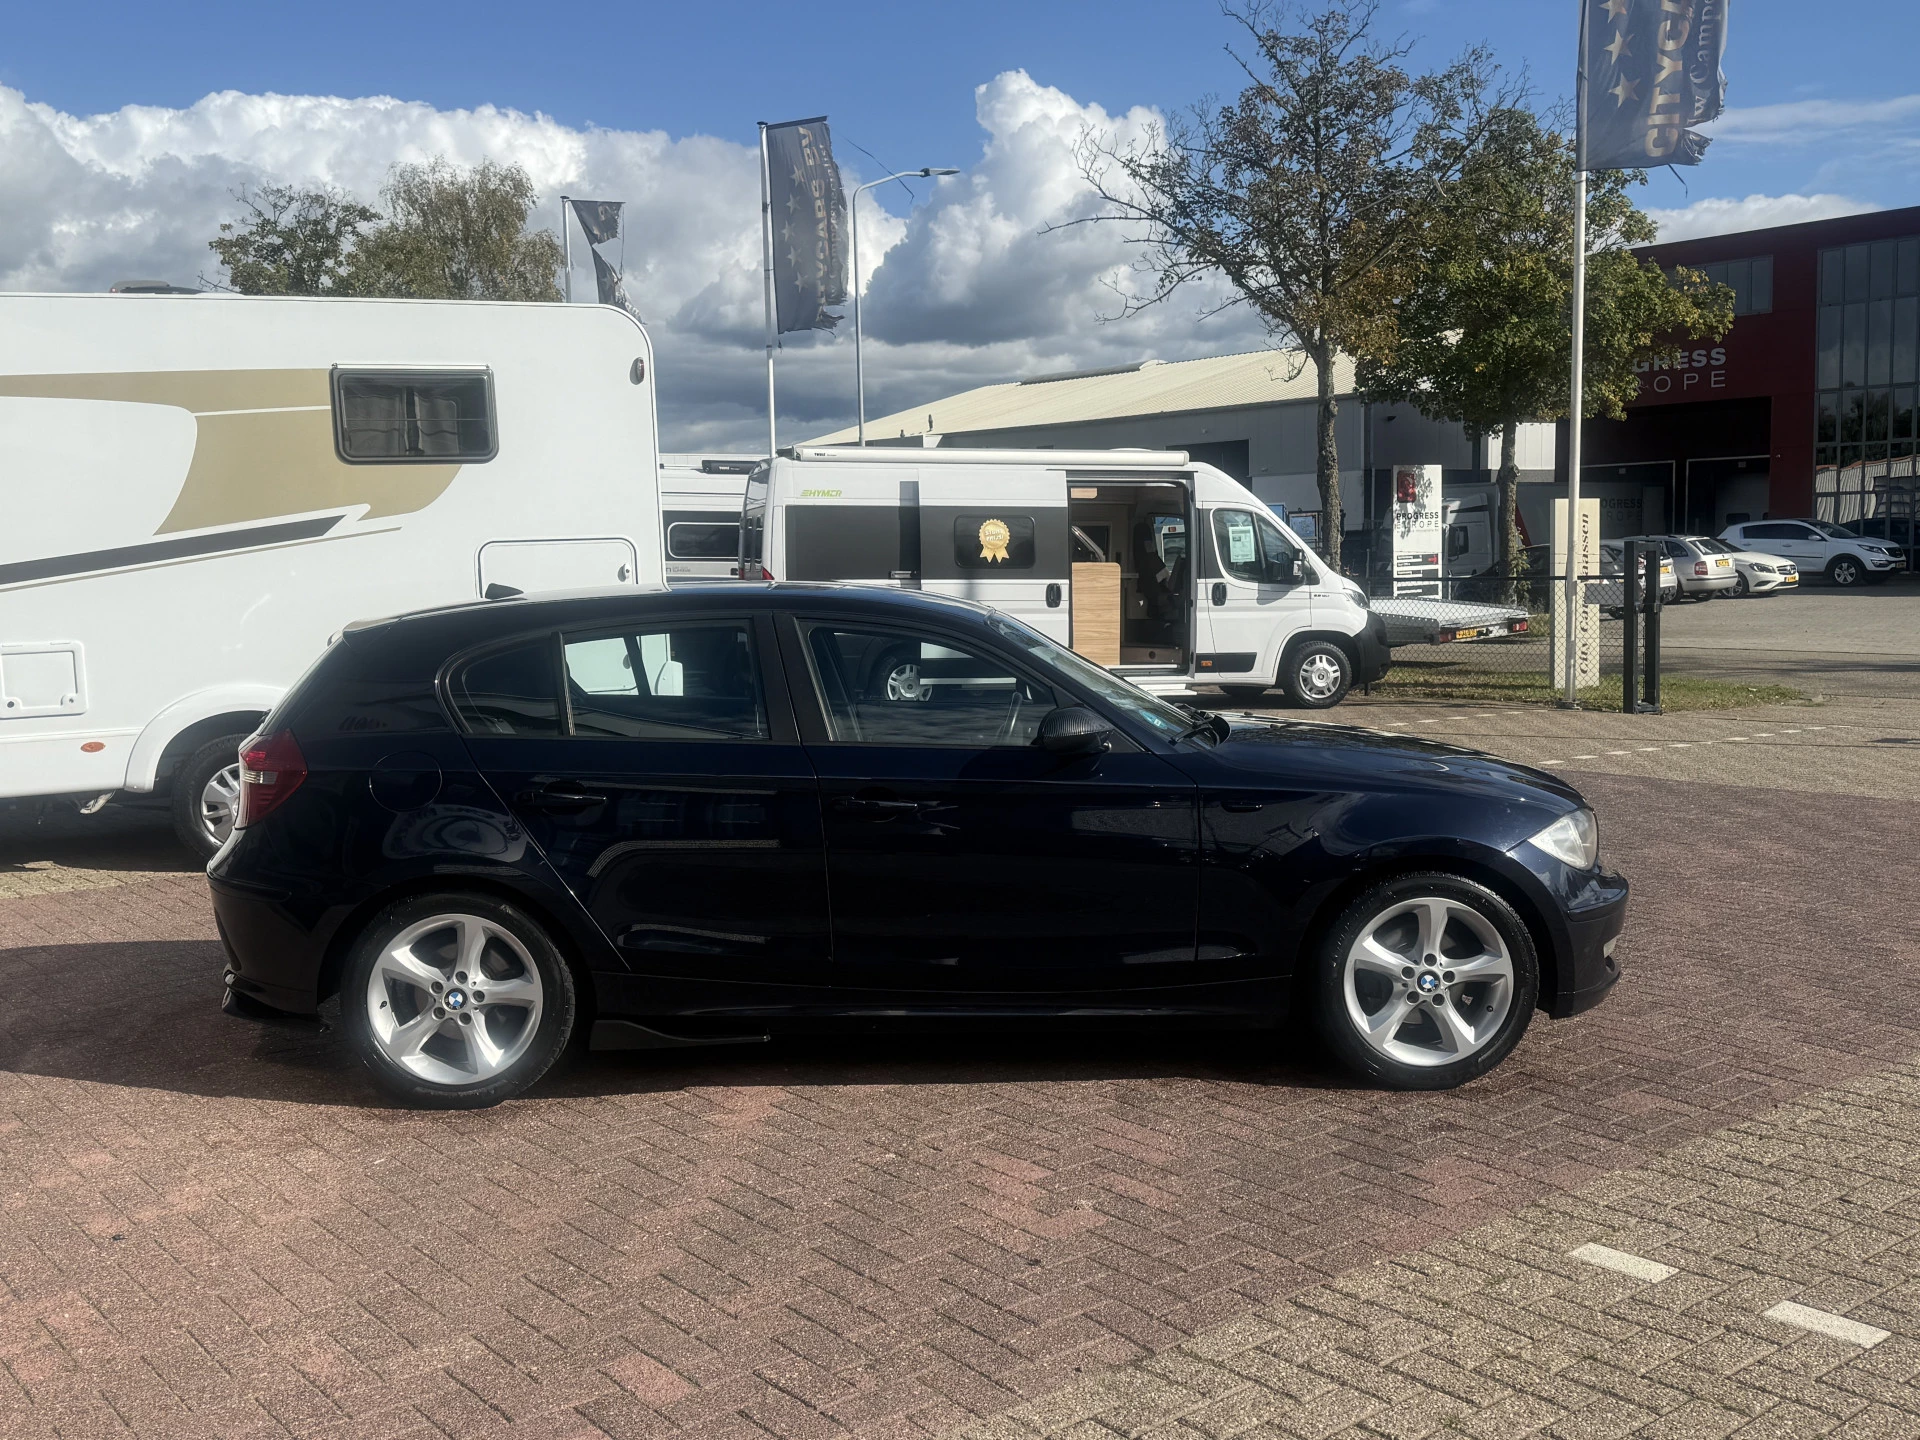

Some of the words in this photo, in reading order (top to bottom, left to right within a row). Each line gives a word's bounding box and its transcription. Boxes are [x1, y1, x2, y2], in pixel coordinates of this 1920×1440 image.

[811, 179, 829, 322] ITYCARS
[1632, 347, 1727, 373] GRESS
[1396, 511, 1439, 521] PROGRESS
[1580, 513, 1590, 584] aassen
